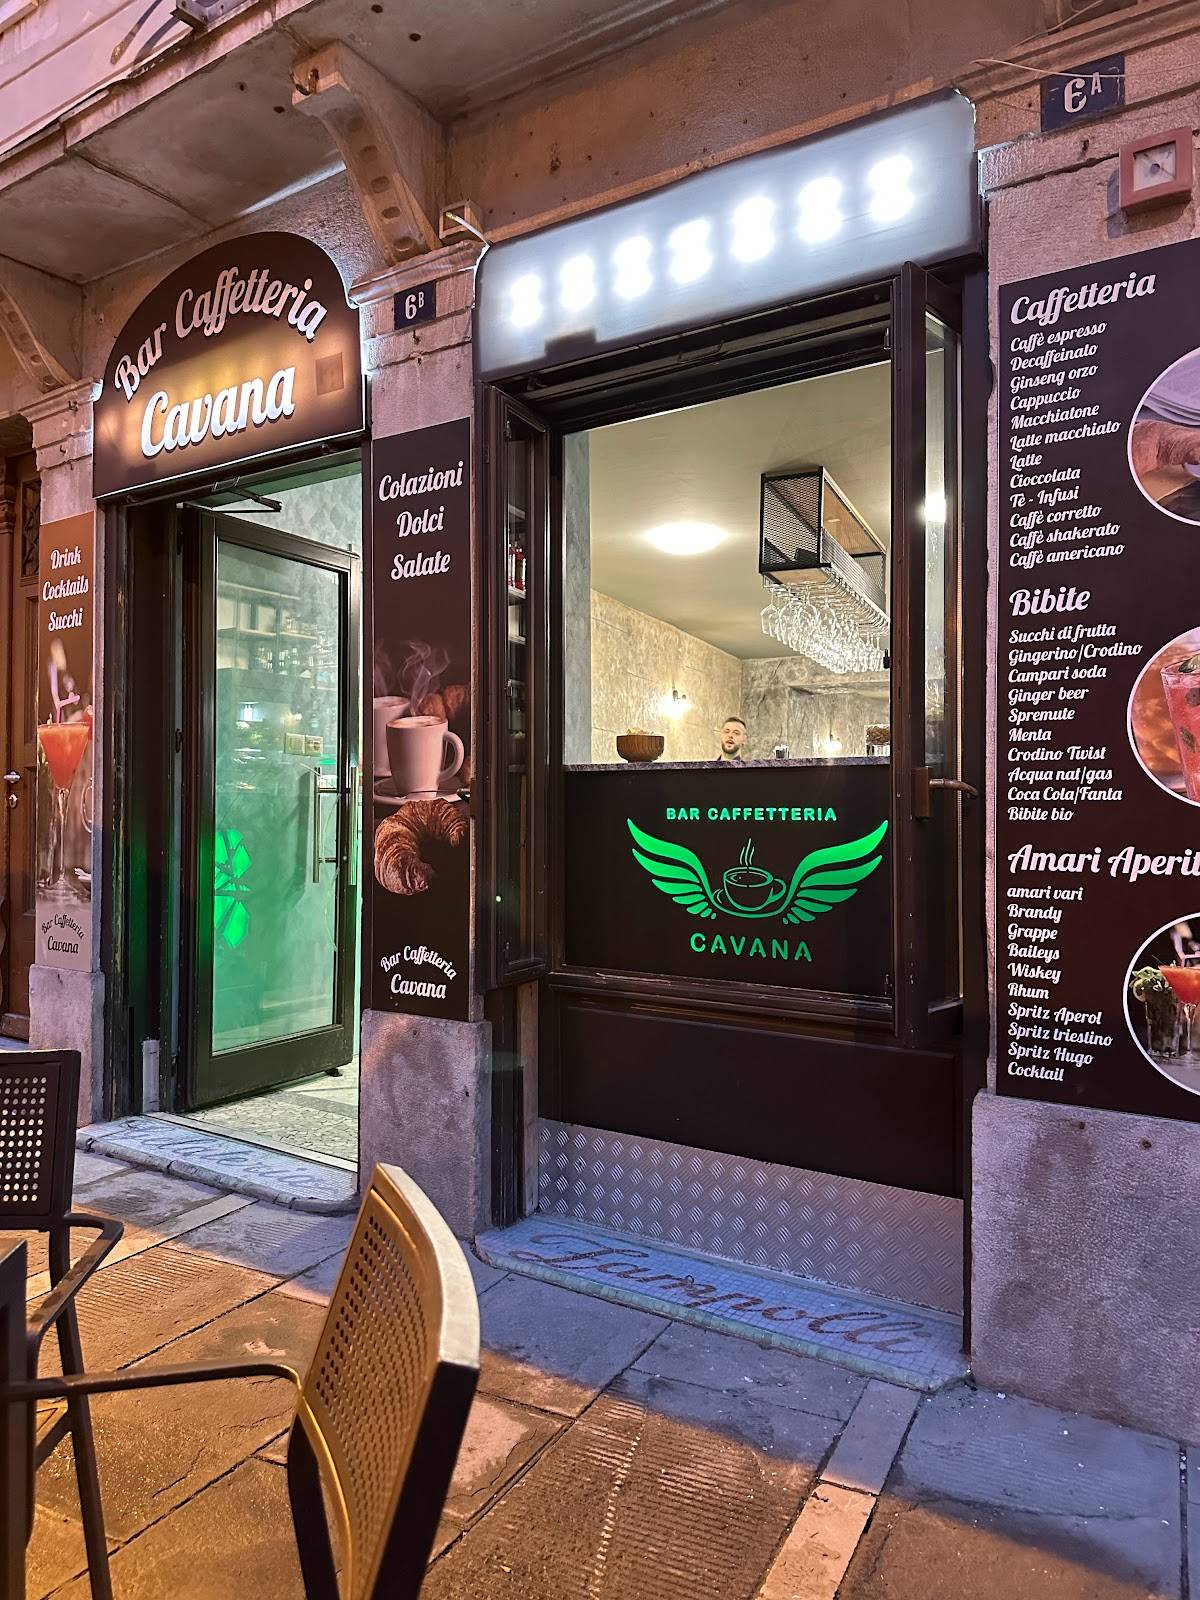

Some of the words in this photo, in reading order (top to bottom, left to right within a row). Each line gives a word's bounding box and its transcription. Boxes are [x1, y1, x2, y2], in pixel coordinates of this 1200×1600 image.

[1010, 272, 1156, 326] Caffetteria
[114, 322, 167, 401] Bar
[175, 266, 328, 340] Caffetteria
[1010, 334, 1045, 354] Caffè
[1047, 321, 1107, 345] espresso
[1010, 343, 1098, 371] Decaffeinato
[1010, 373, 1065, 394] Ginseng
[1068, 364, 1098, 380] orzo
[141, 366, 296, 457] Cavana
[1010, 387, 1081, 412] Cappuccio
[1011, 404, 1099, 430] Macchiatone
[1010, 432, 1042, 451] Latte
[1044, 420, 1121, 444] macchiato
[1010, 454, 1042, 471] Latte
[378, 460, 464, 501] Colazioni
[1010, 467, 1081, 488] Cioccolata
[1037, 486, 1080, 506] Infusi
[397, 505, 445, 537] Dolci
[1010, 510, 1044, 530] Caffè
[1046, 505, 1102, 523] corretto
[1010, 530, 1044, 550] Caffè
[1046, 522, 1120, 542] shakerato
[51, 545, 81, 570] Drink
[391, 550, 451, 580] Salate
[1010, 550, 1044, 569] Caffè
[1046, 543, 1125, 563] americano
[42, 575, 89, 601] Cocktails
[1009, 586, 1091, 616] Bibite
[48, 607, 83, 632] Succhi
[1009, 627, 1055, 644] Succhi
[1057, 624, 1073, 640] di
[1071, 623, 1116, 642] frutta
[1008, 642, 1143, 667] Gingerino/Crodino
[1008, 666, 1068, 685] Campari
[1071, 665, 1107, 680] soda
[1008, 688, 1055, 706] Ginger
[1058, 687, 1089, 701] beer
[1008, 707, 1075, 725] Spremute
[1008, 728, 1052, 742] Menta
[1008, 747, 1063, 762] Crodino
[1067, 746, 1106, 761] Twist
[1008, 767, 1053, 784] Acqua
[1055, 767, 1113, 784] nat/gas
[1008, 787, 1040, 801] Coca
[1043, 786, 1123, 804] Cola/Fanta
[666, 807, 700, 820] BAR
[707, 807, 837, 821] CAFFETTERIA
[1008, 806, 1048, 821] Bibite
[1051, 807, 1074, 821] bio
[1008, 844, 1102, 873] Amari
[1007, 886, 1051, 900] amari
[1053, 887, 1083, 901] vari
[1007, 904, 1062, 923] Brandy
[48, 936, 79, 954] Cavana
[1007, 923, 1058, 943] Grappe
[689, 932, 813, 962] CAVANA
[1007, 943, 1060, 963] Baileys
[381, 952, 401, 972] Bar
[404, 945, 457, 980] Caffetteria
[1007, 962, 1061, 984] Wiskey
[391, 973, 447, 999] Cavana
[1007, 982, 1049, 1000] Rhum
[1007, 1002, 1050, 1020] Spritz
[1054, 1007, 1102, 1025] Aperol
[1007, 1022, 1050, 1041] Spritz
[1053, 1028, 1113, 1047] triestino
[1007, 1042, 1050, 1060] Spritz
[1053, 1047, 1094, 1068] Hugo
[1007, 1062, 1064, 1081] Cocktail
